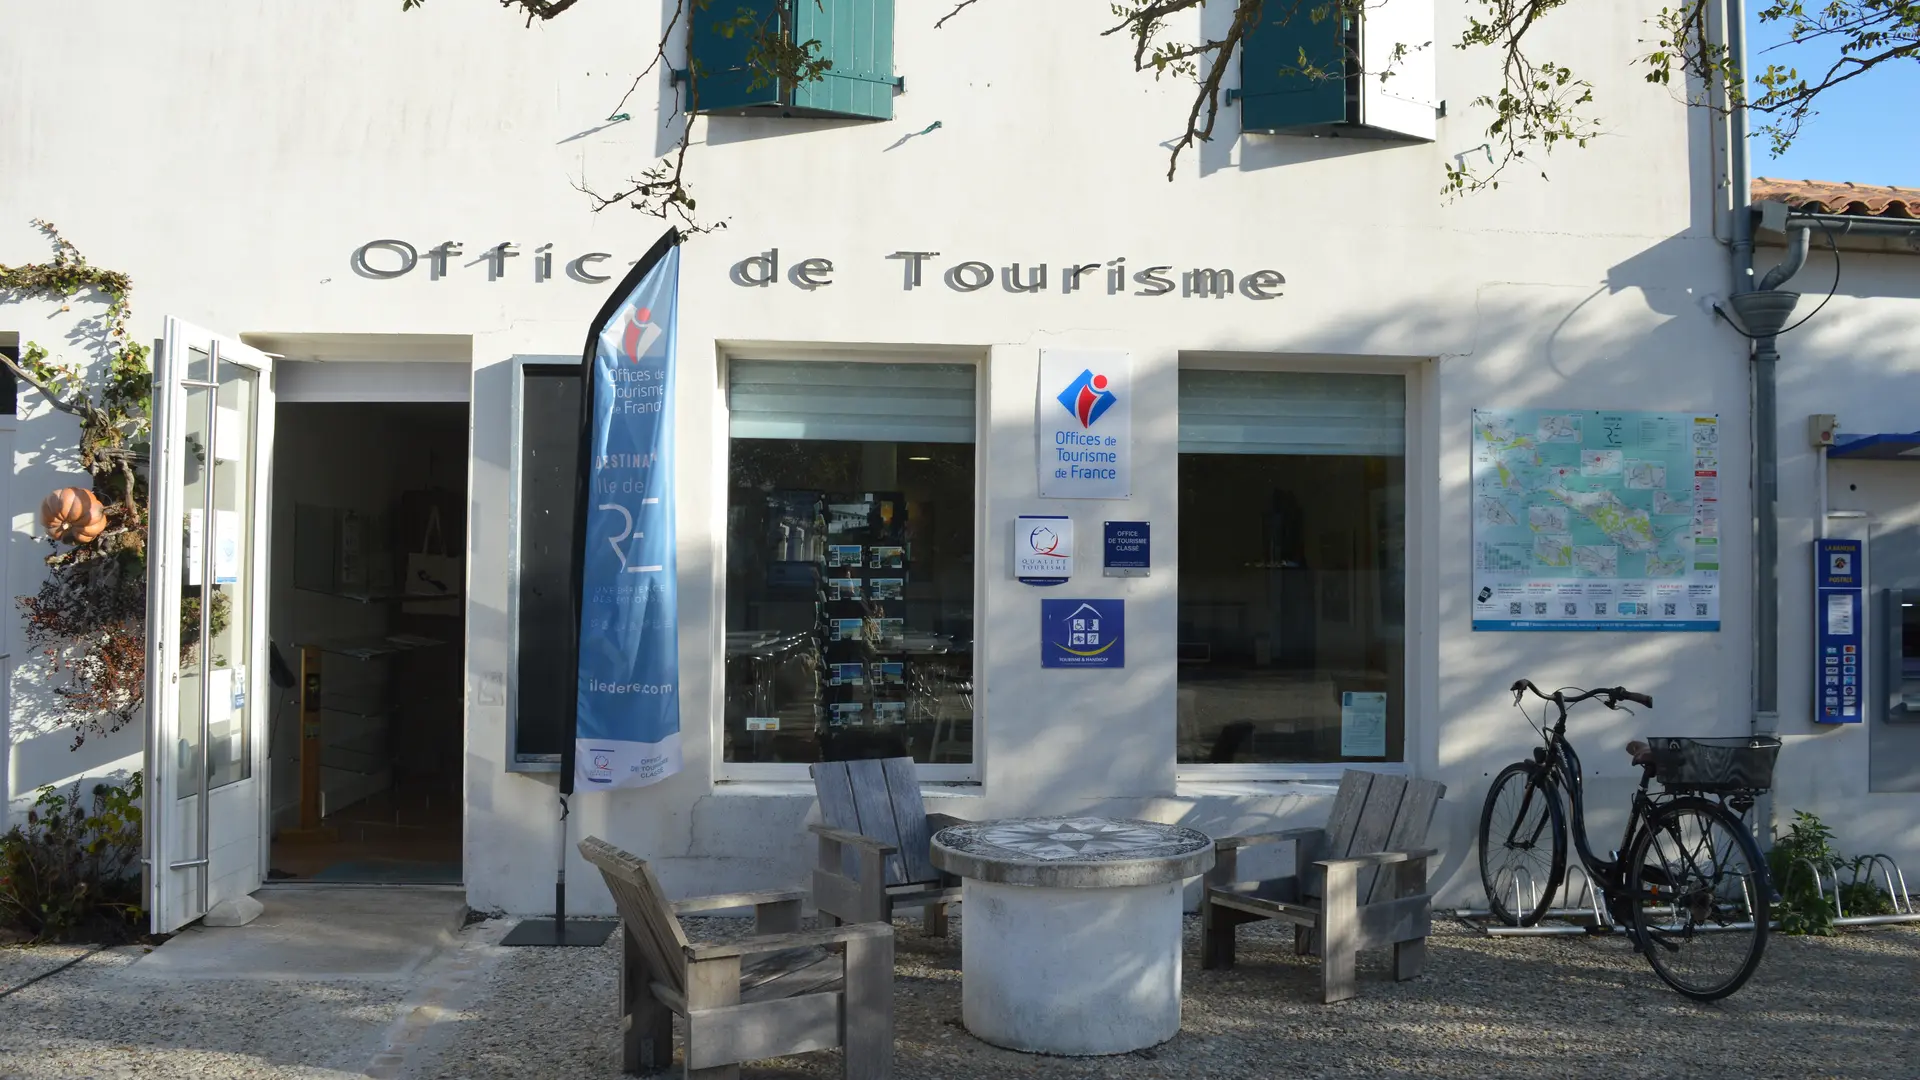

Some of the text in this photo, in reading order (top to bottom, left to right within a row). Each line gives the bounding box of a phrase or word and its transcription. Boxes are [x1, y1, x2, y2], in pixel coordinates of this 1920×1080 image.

[352, 239, 1287, 300] Offic de Tourisme
[608, 368, 651, 382] Offices
[608, 384, 664, 399] Tourisme
[1055, 430, 1117, 446] Offices de
[1055, 447, 1117, 463] Tourisme
[1054, 465, 1117, 480] de France
[622, 477, 645, 494] de
[589, 679, 672, 695] iledere.com
